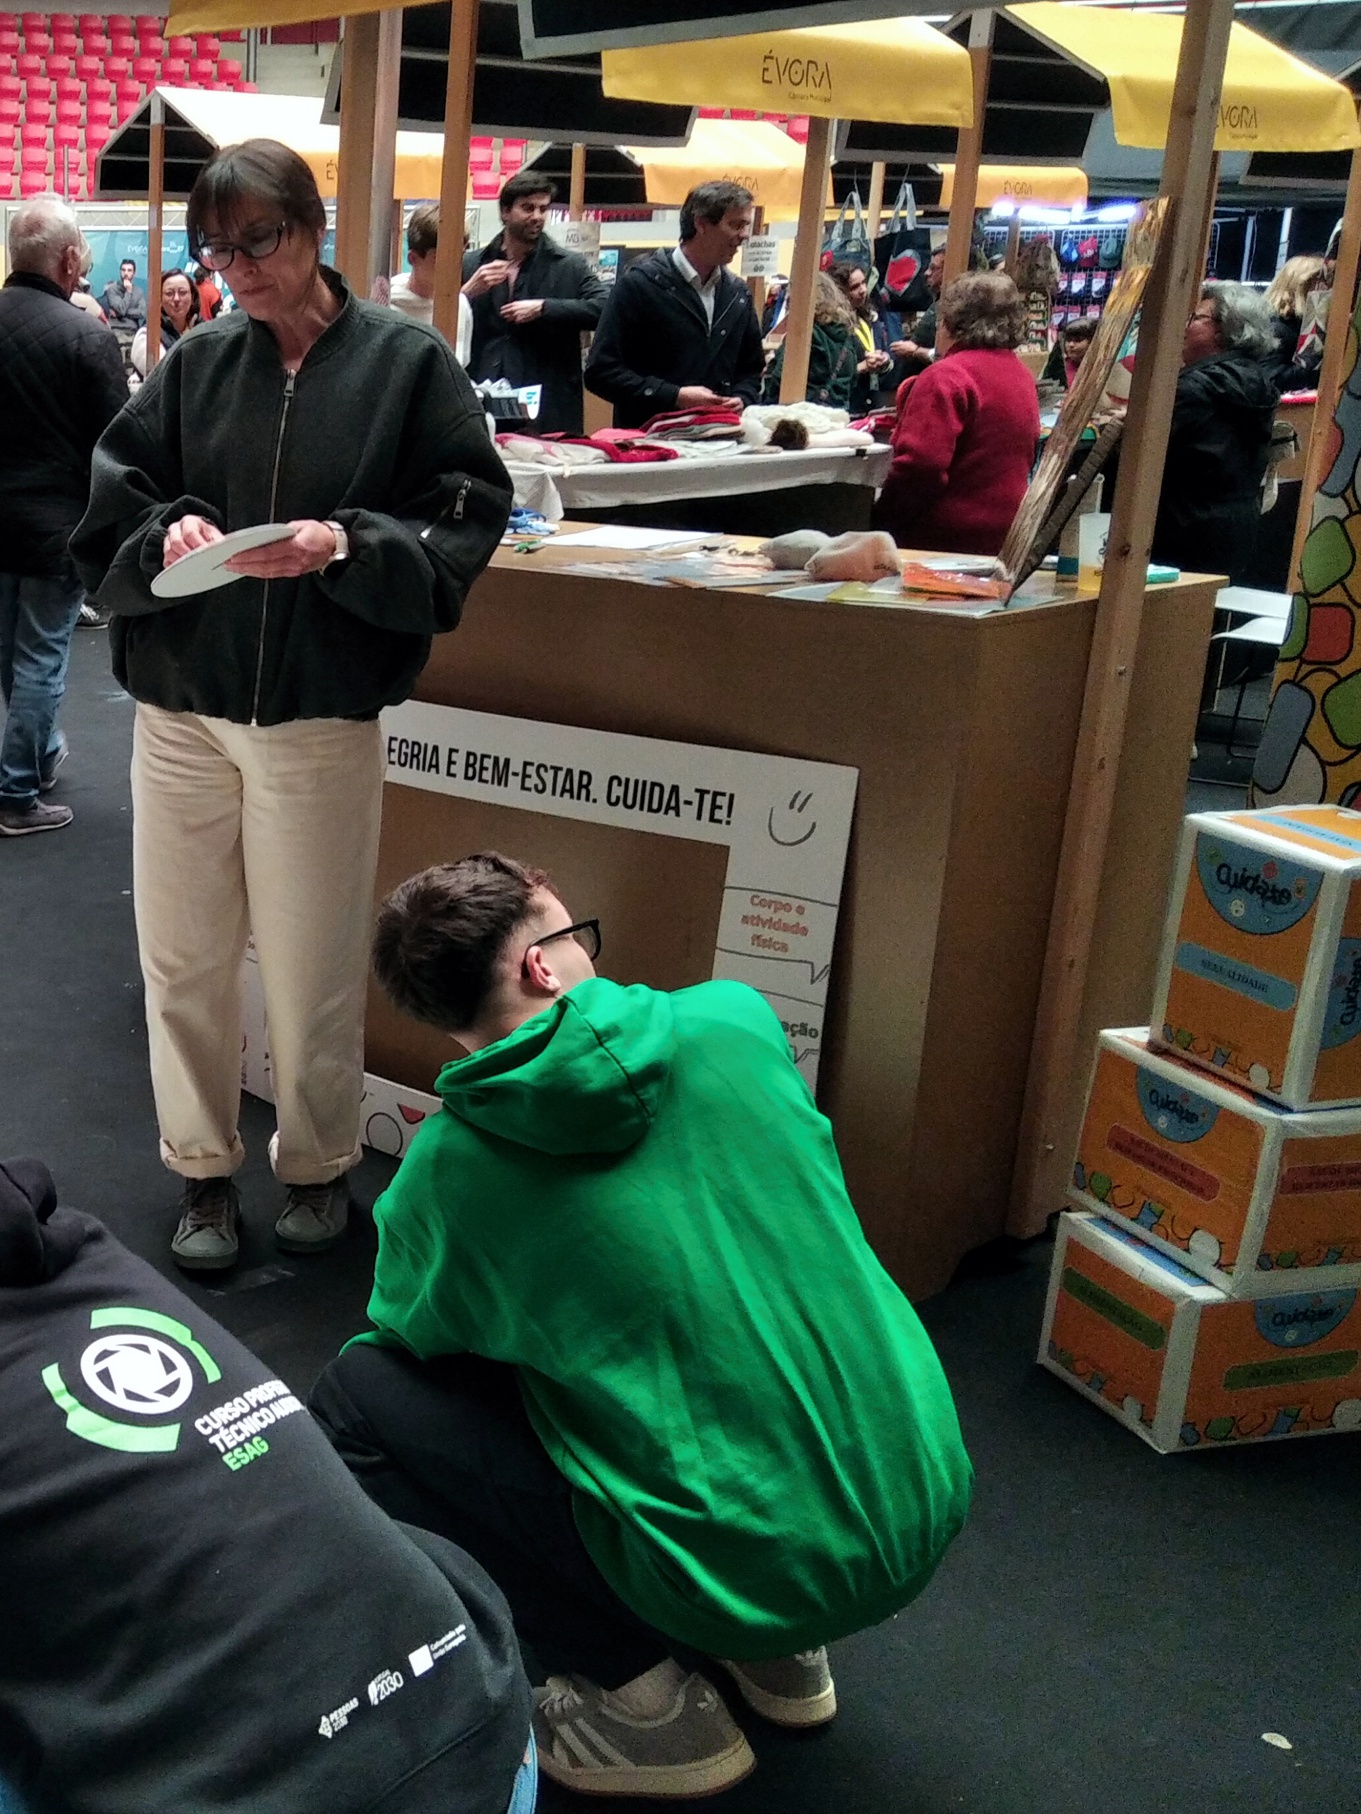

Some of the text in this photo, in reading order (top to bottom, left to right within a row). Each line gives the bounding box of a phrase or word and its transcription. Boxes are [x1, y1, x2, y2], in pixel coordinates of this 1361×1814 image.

[762, 49, 831, 90] ÉVORA
[1220, 105, 1257, 128] VORA
[388, 736, 735, 827] EGRIA E BEM-ESTAR. CUIDA-TE!
[749, 894, 806, 916] Corpo e
[740, 914, 810, 937] atividade
[750, 933, 789, 954] física
[782, 1020, 819, 1039] ação
[194, 1397, 250, 1435] CURSO
[208, 1407, 276, 1453] TÉCNICO
[222, 1435, 269, 1471] ESAG
[377, 1671, 404, 1700] 2030
